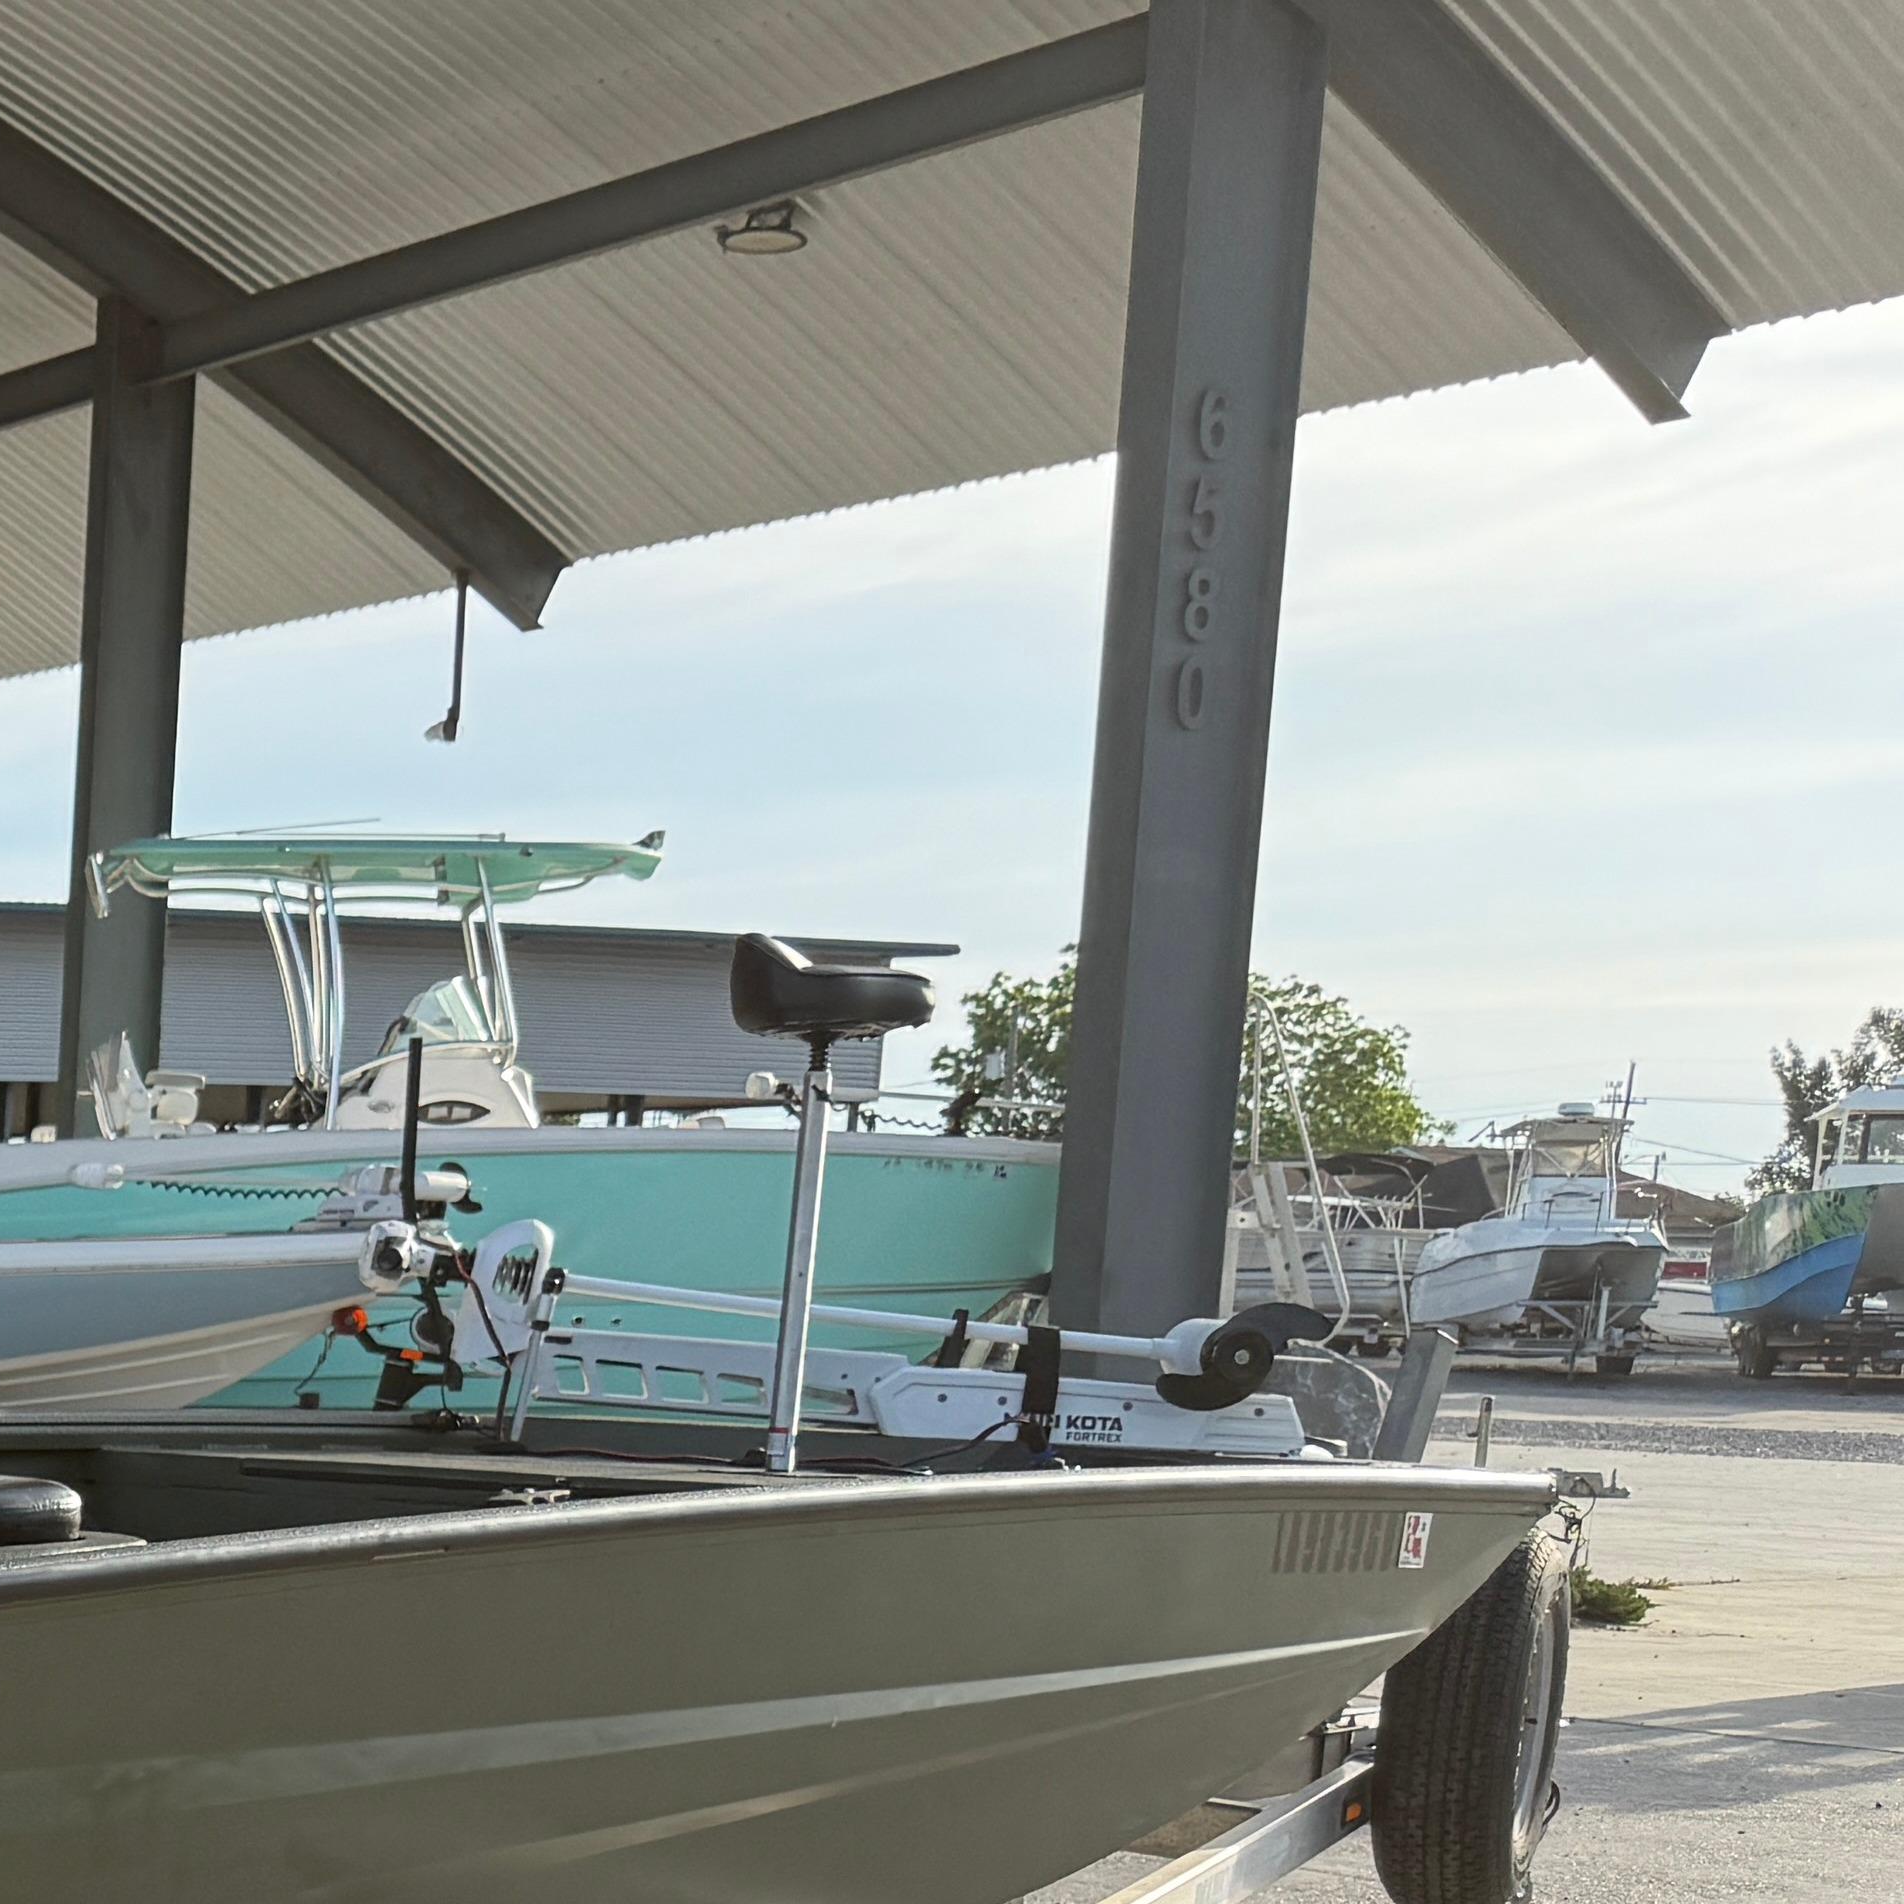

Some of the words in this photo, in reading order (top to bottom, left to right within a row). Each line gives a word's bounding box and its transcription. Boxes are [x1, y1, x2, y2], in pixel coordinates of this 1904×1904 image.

[1174, 387, 1230, 733] 6580
[1065, 1414, 1123, 1431] KOTA
[1065, 1431, 1122, 1443] FORTREX
